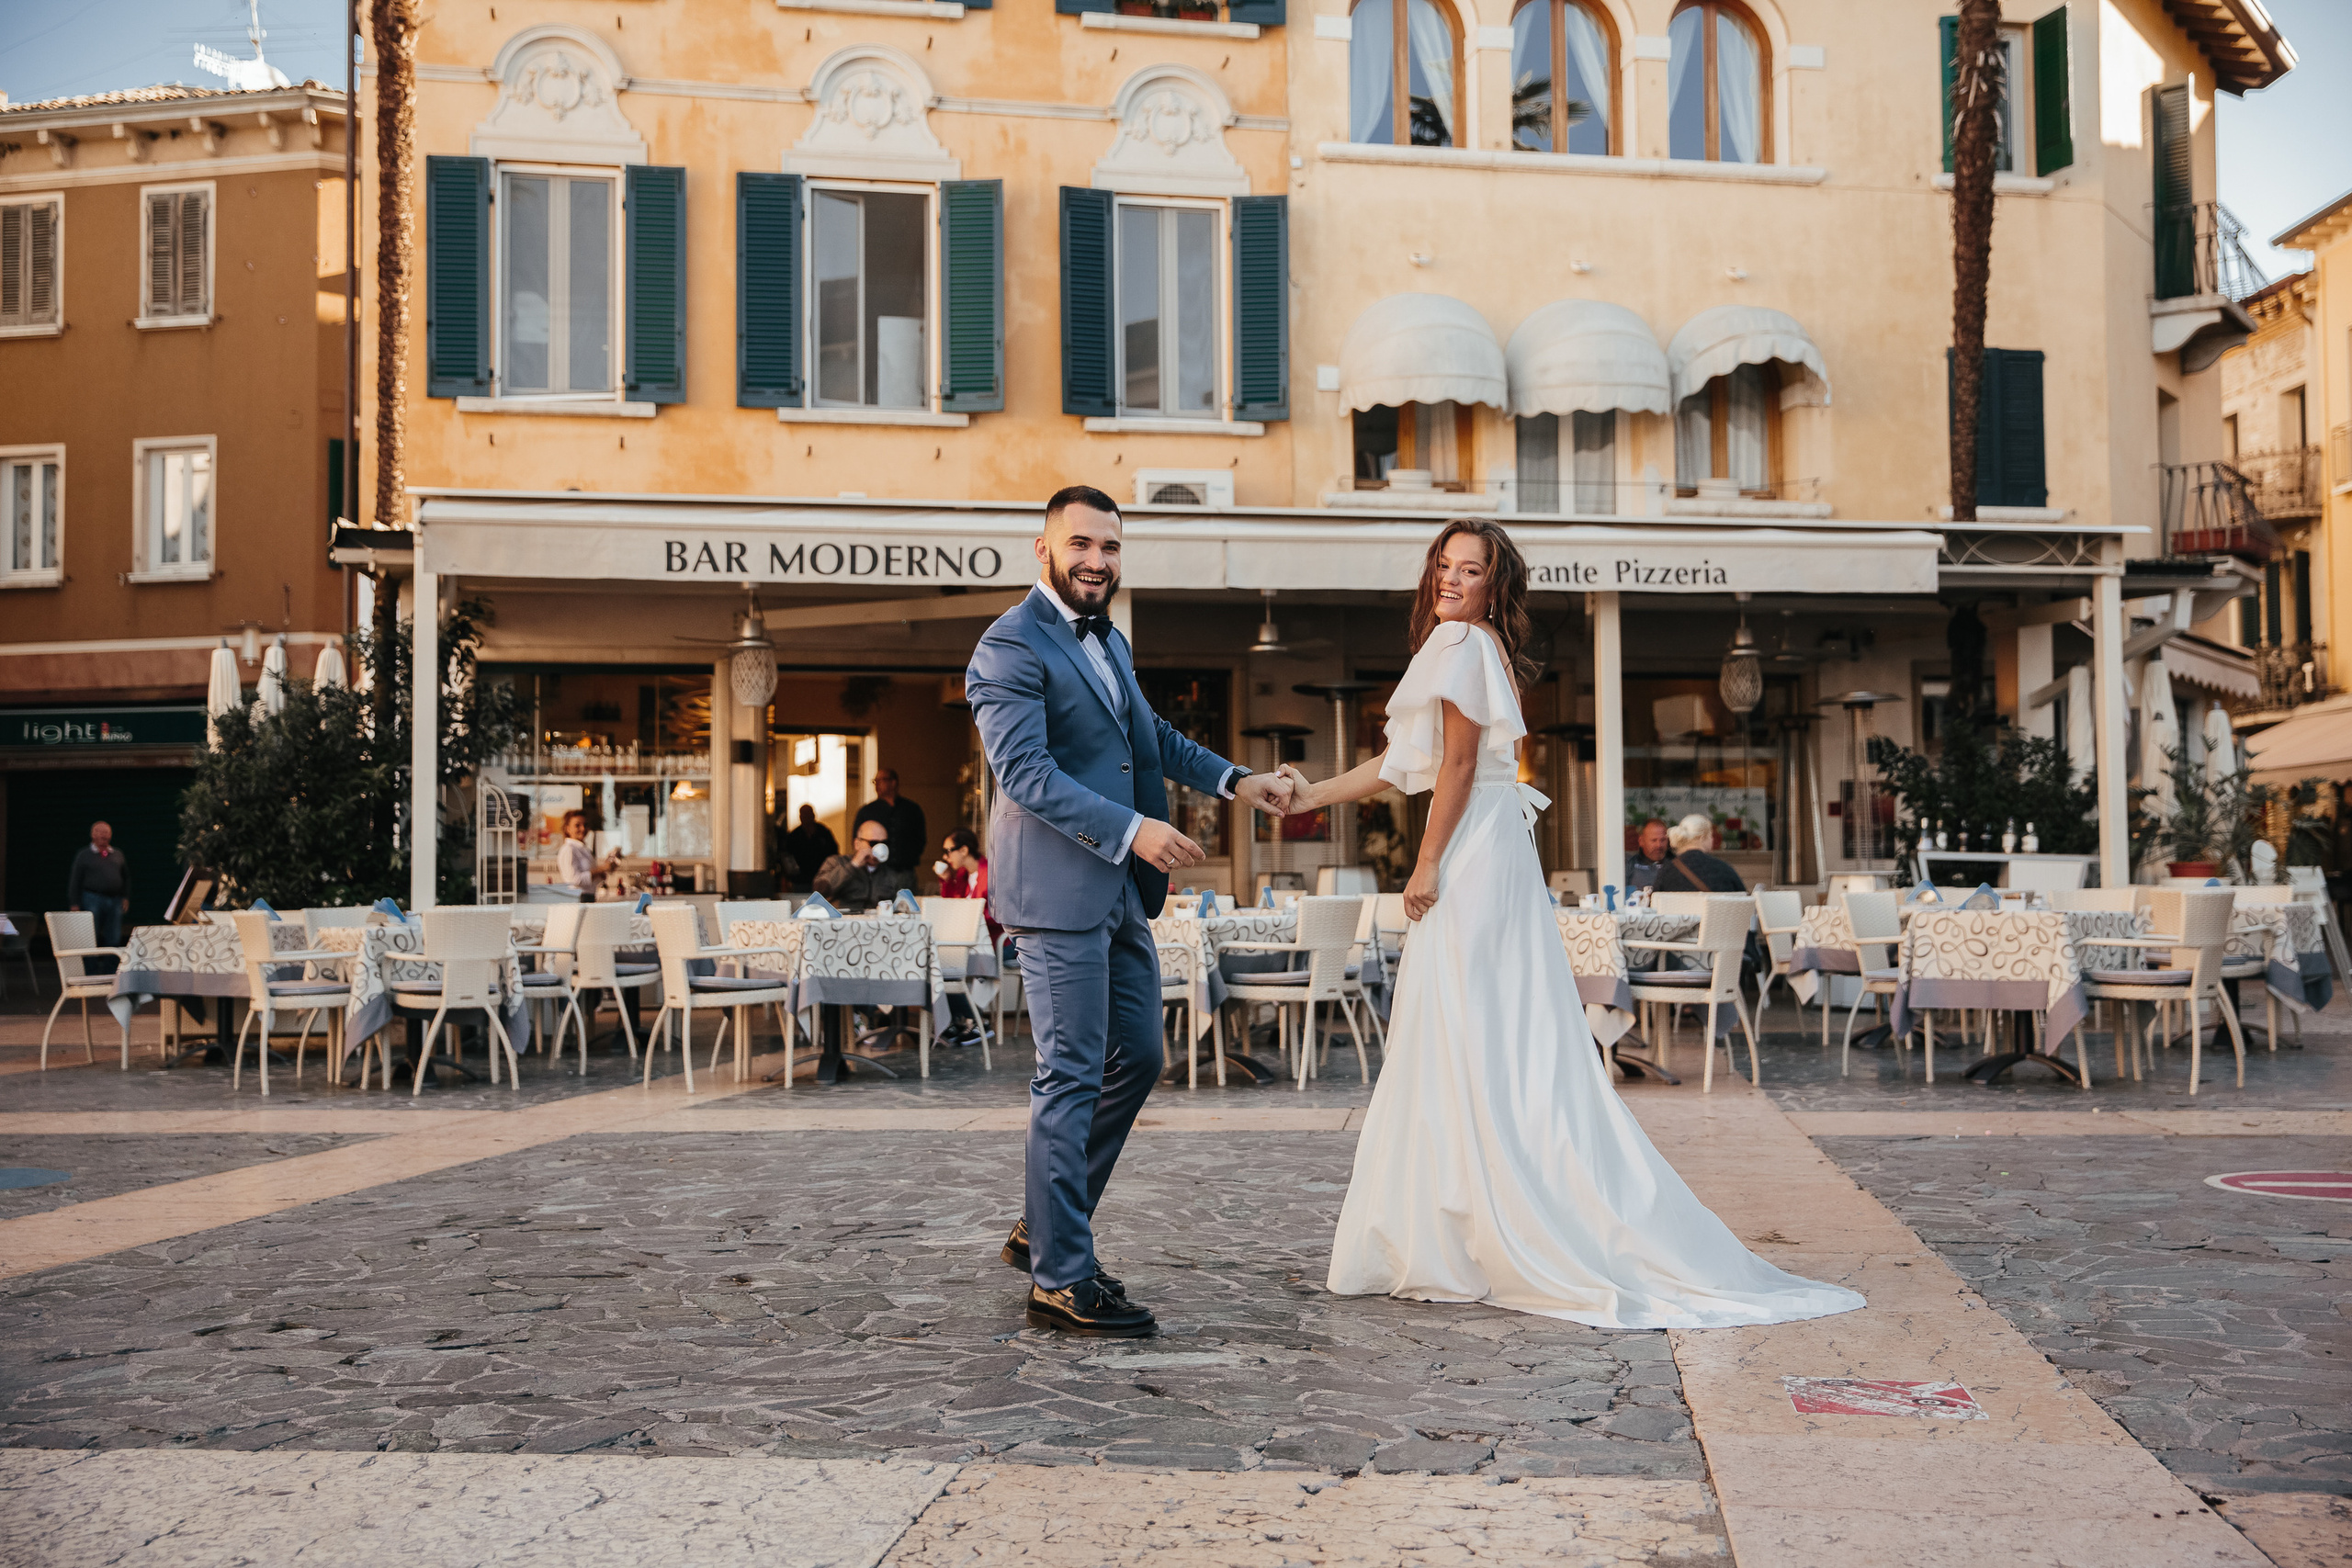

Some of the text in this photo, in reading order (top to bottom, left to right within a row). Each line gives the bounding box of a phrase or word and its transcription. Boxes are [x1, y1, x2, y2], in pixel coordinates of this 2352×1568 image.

[665, 540, 1002, 579] BAR MODERNO
[1527, 559, 1727, 585] rante Pizzeria
[23, 720, 96, 745] light
